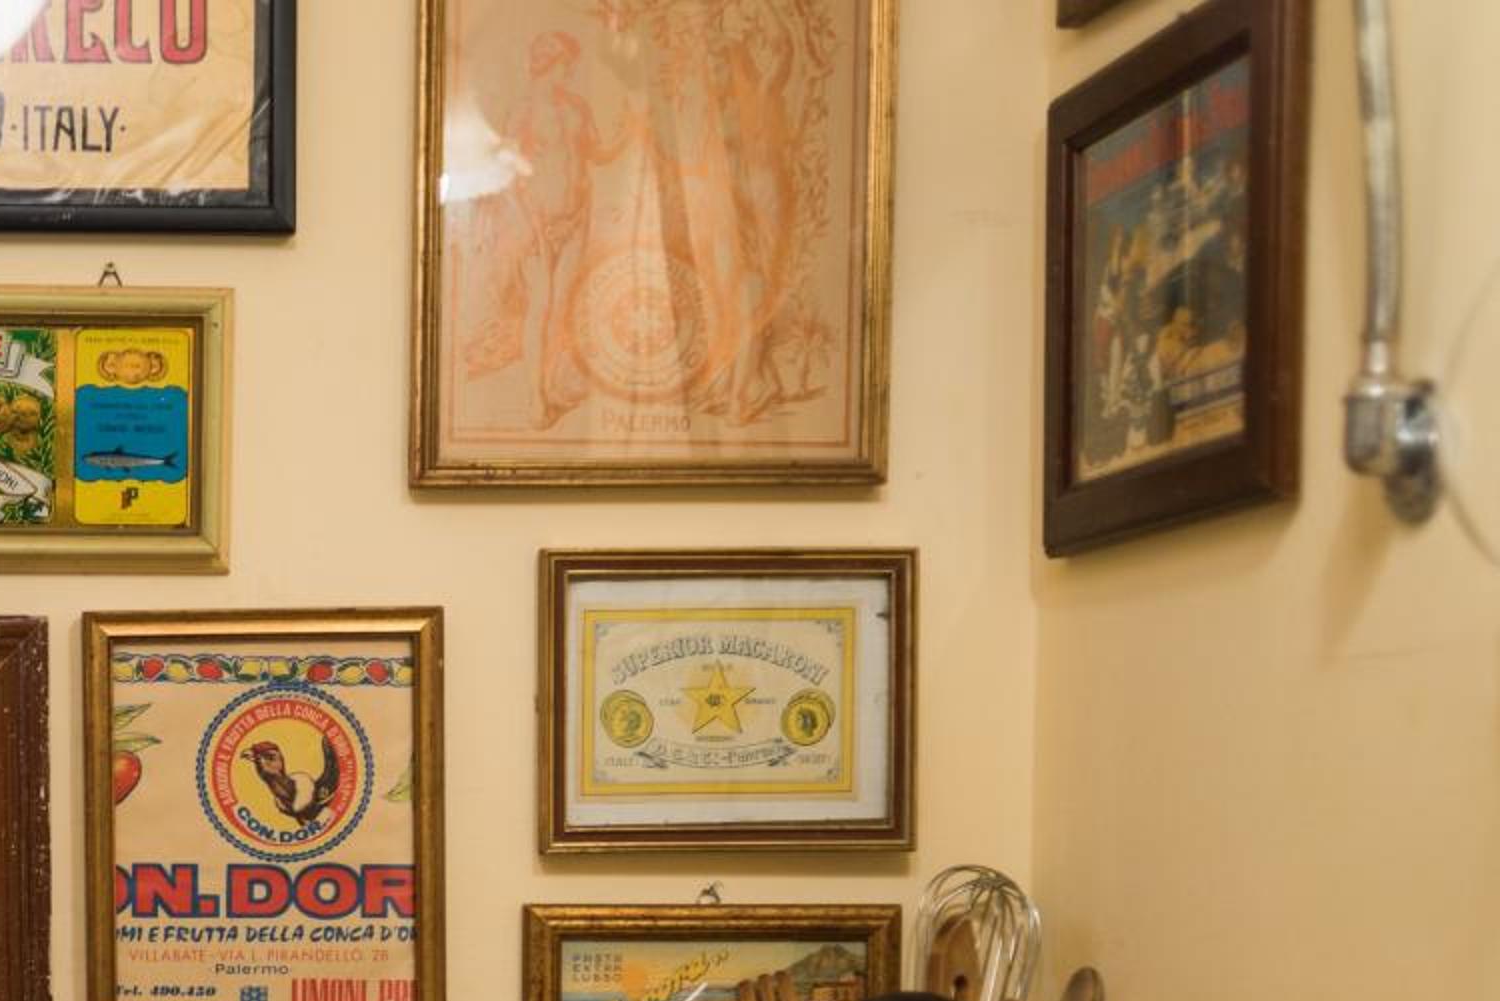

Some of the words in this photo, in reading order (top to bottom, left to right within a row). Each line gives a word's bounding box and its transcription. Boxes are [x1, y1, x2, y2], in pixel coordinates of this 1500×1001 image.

[148, 925, 160, 942] E
[163, 925, 239, 943] FRUTTA
[246, 924, 305, 942] DELLA
[310, 924, 375, 943] CONCA
[214, 963, 290, 976] Palermo
